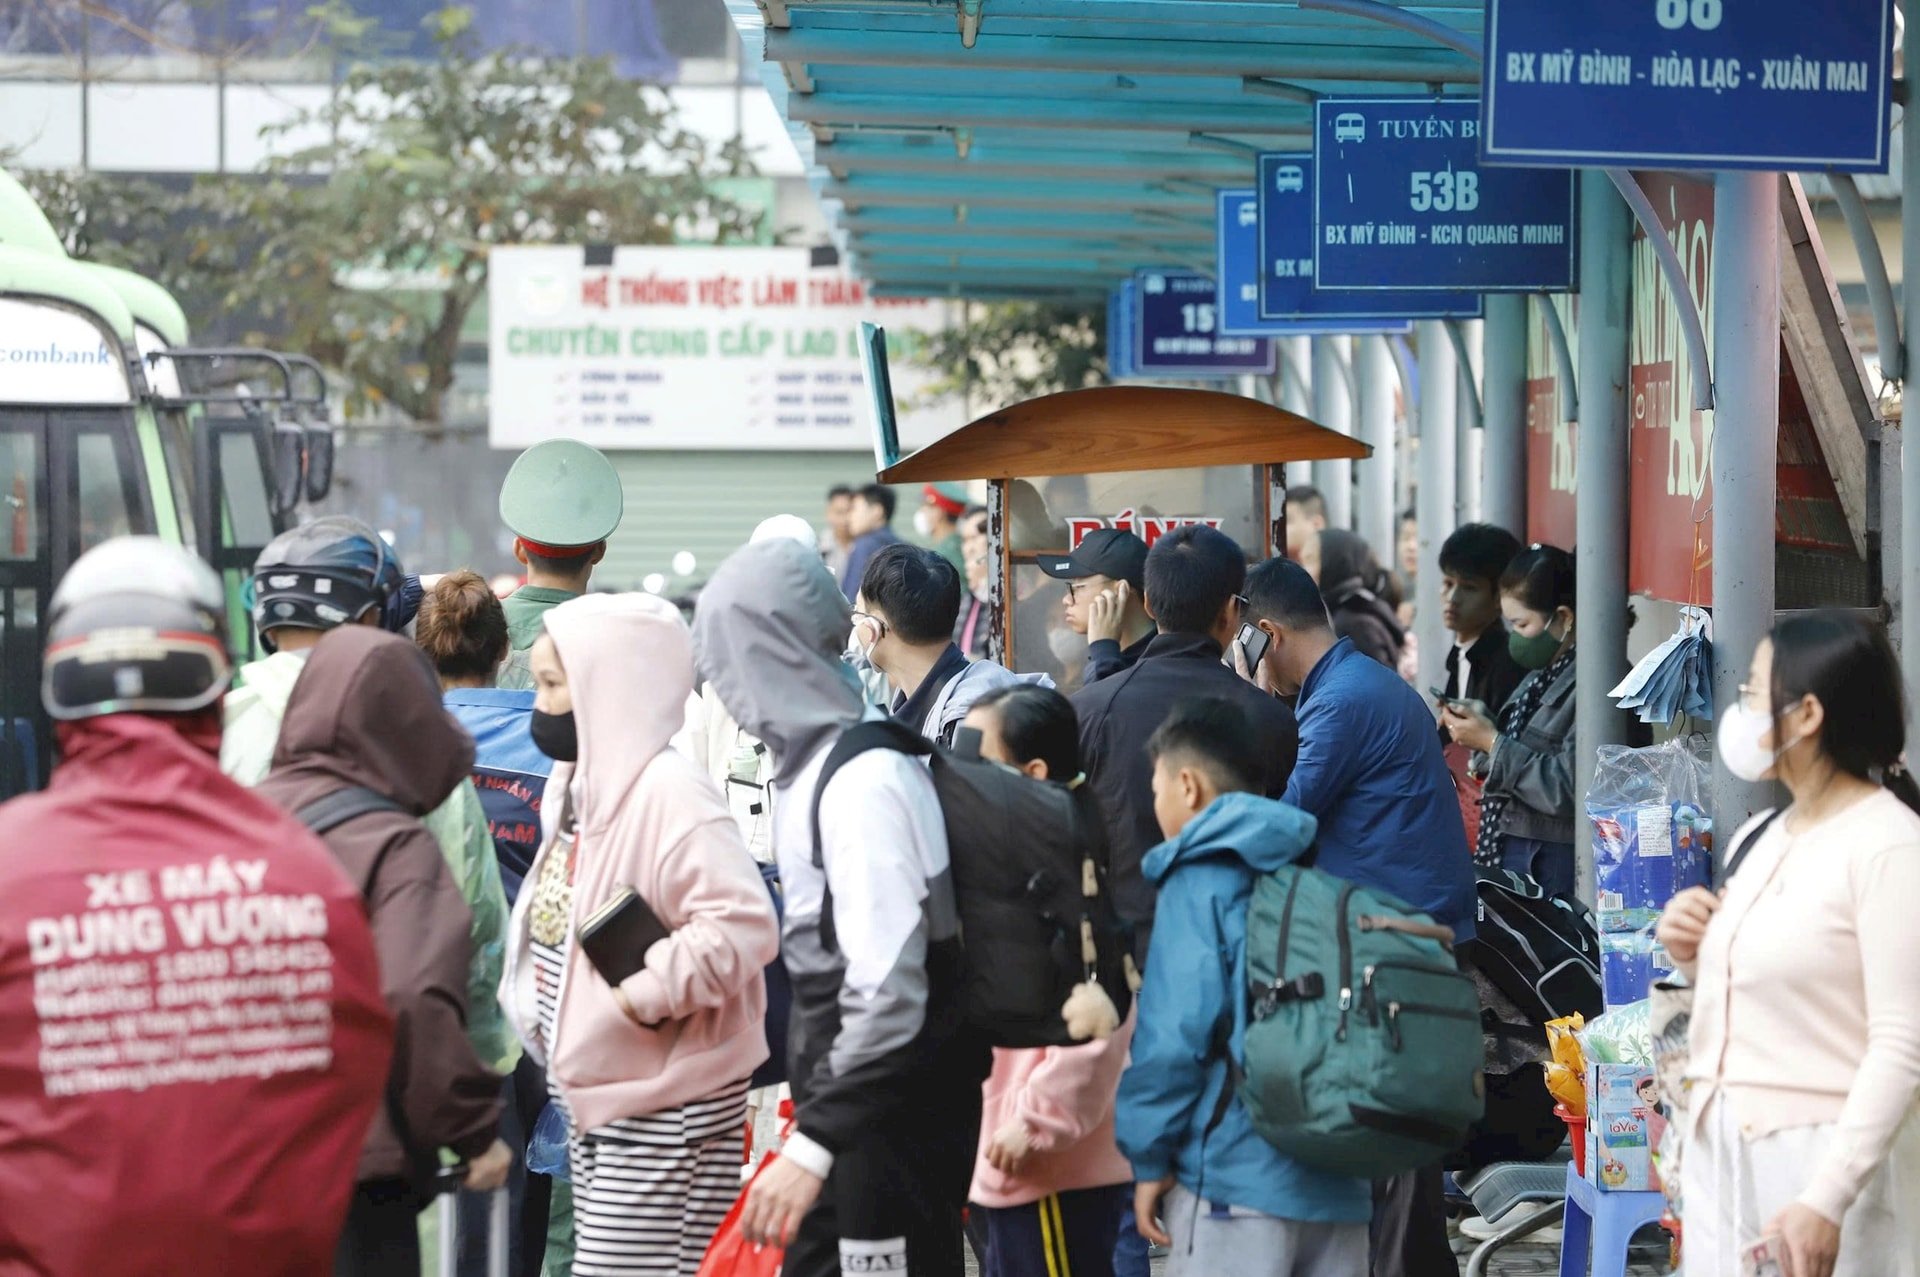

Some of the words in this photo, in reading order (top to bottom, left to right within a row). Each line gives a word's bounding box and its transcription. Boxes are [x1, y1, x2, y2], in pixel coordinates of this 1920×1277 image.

[1507, 52, 1535, 82] BX
[1541, 49, 1574, 83] MỸ
[1579, 48, 1631, 85] ĐÌNH
[1652, 50, 1695, 87] HÒA
[1701, 58, 1741, 95] LẠC
[1761, 54, 1820, 91] XUÂN
[1826, 61, 1868, 92] MAI
[1410, 170, 1479, 212] 53B
[1326, 225, 1346, 244] BX
[1351, 221, 1374, 244] MỸ
[1379, 221, 1416, 244] ĐÌNH
[1431, 225, 1462, 244] KCN
[1467, 225, 1518, 246] QUANG
[1522, 225, 1564, 244] MINH
[1275, 259, 1296, 277] BX
[1299, 259, 1313, 277] M
[1181, 303, 1216, 333] 15
[86, 870, 152, 907] XE
